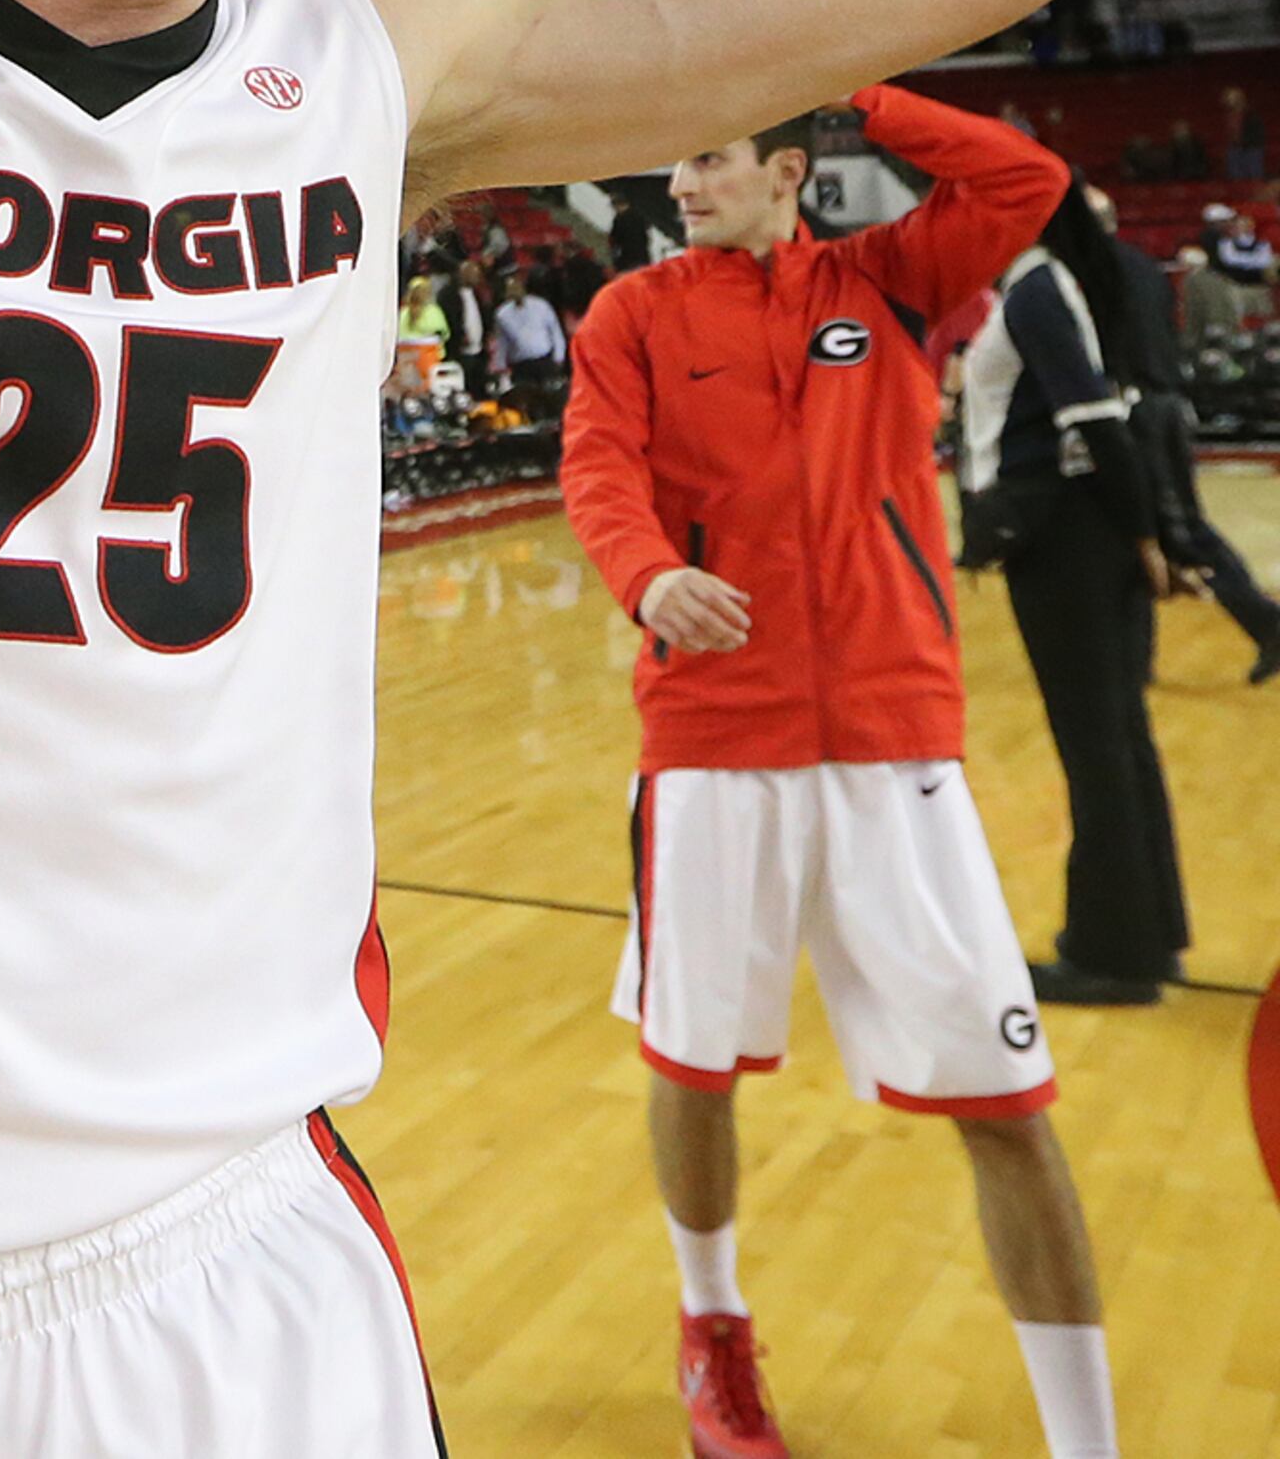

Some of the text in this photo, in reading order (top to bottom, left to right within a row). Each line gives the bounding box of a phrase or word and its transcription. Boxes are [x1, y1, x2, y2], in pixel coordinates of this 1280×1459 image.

[245, 67, 303, 109] SEC
[812, 319, 871, 364] G
[1000, 1005, 1037, 1051] G
